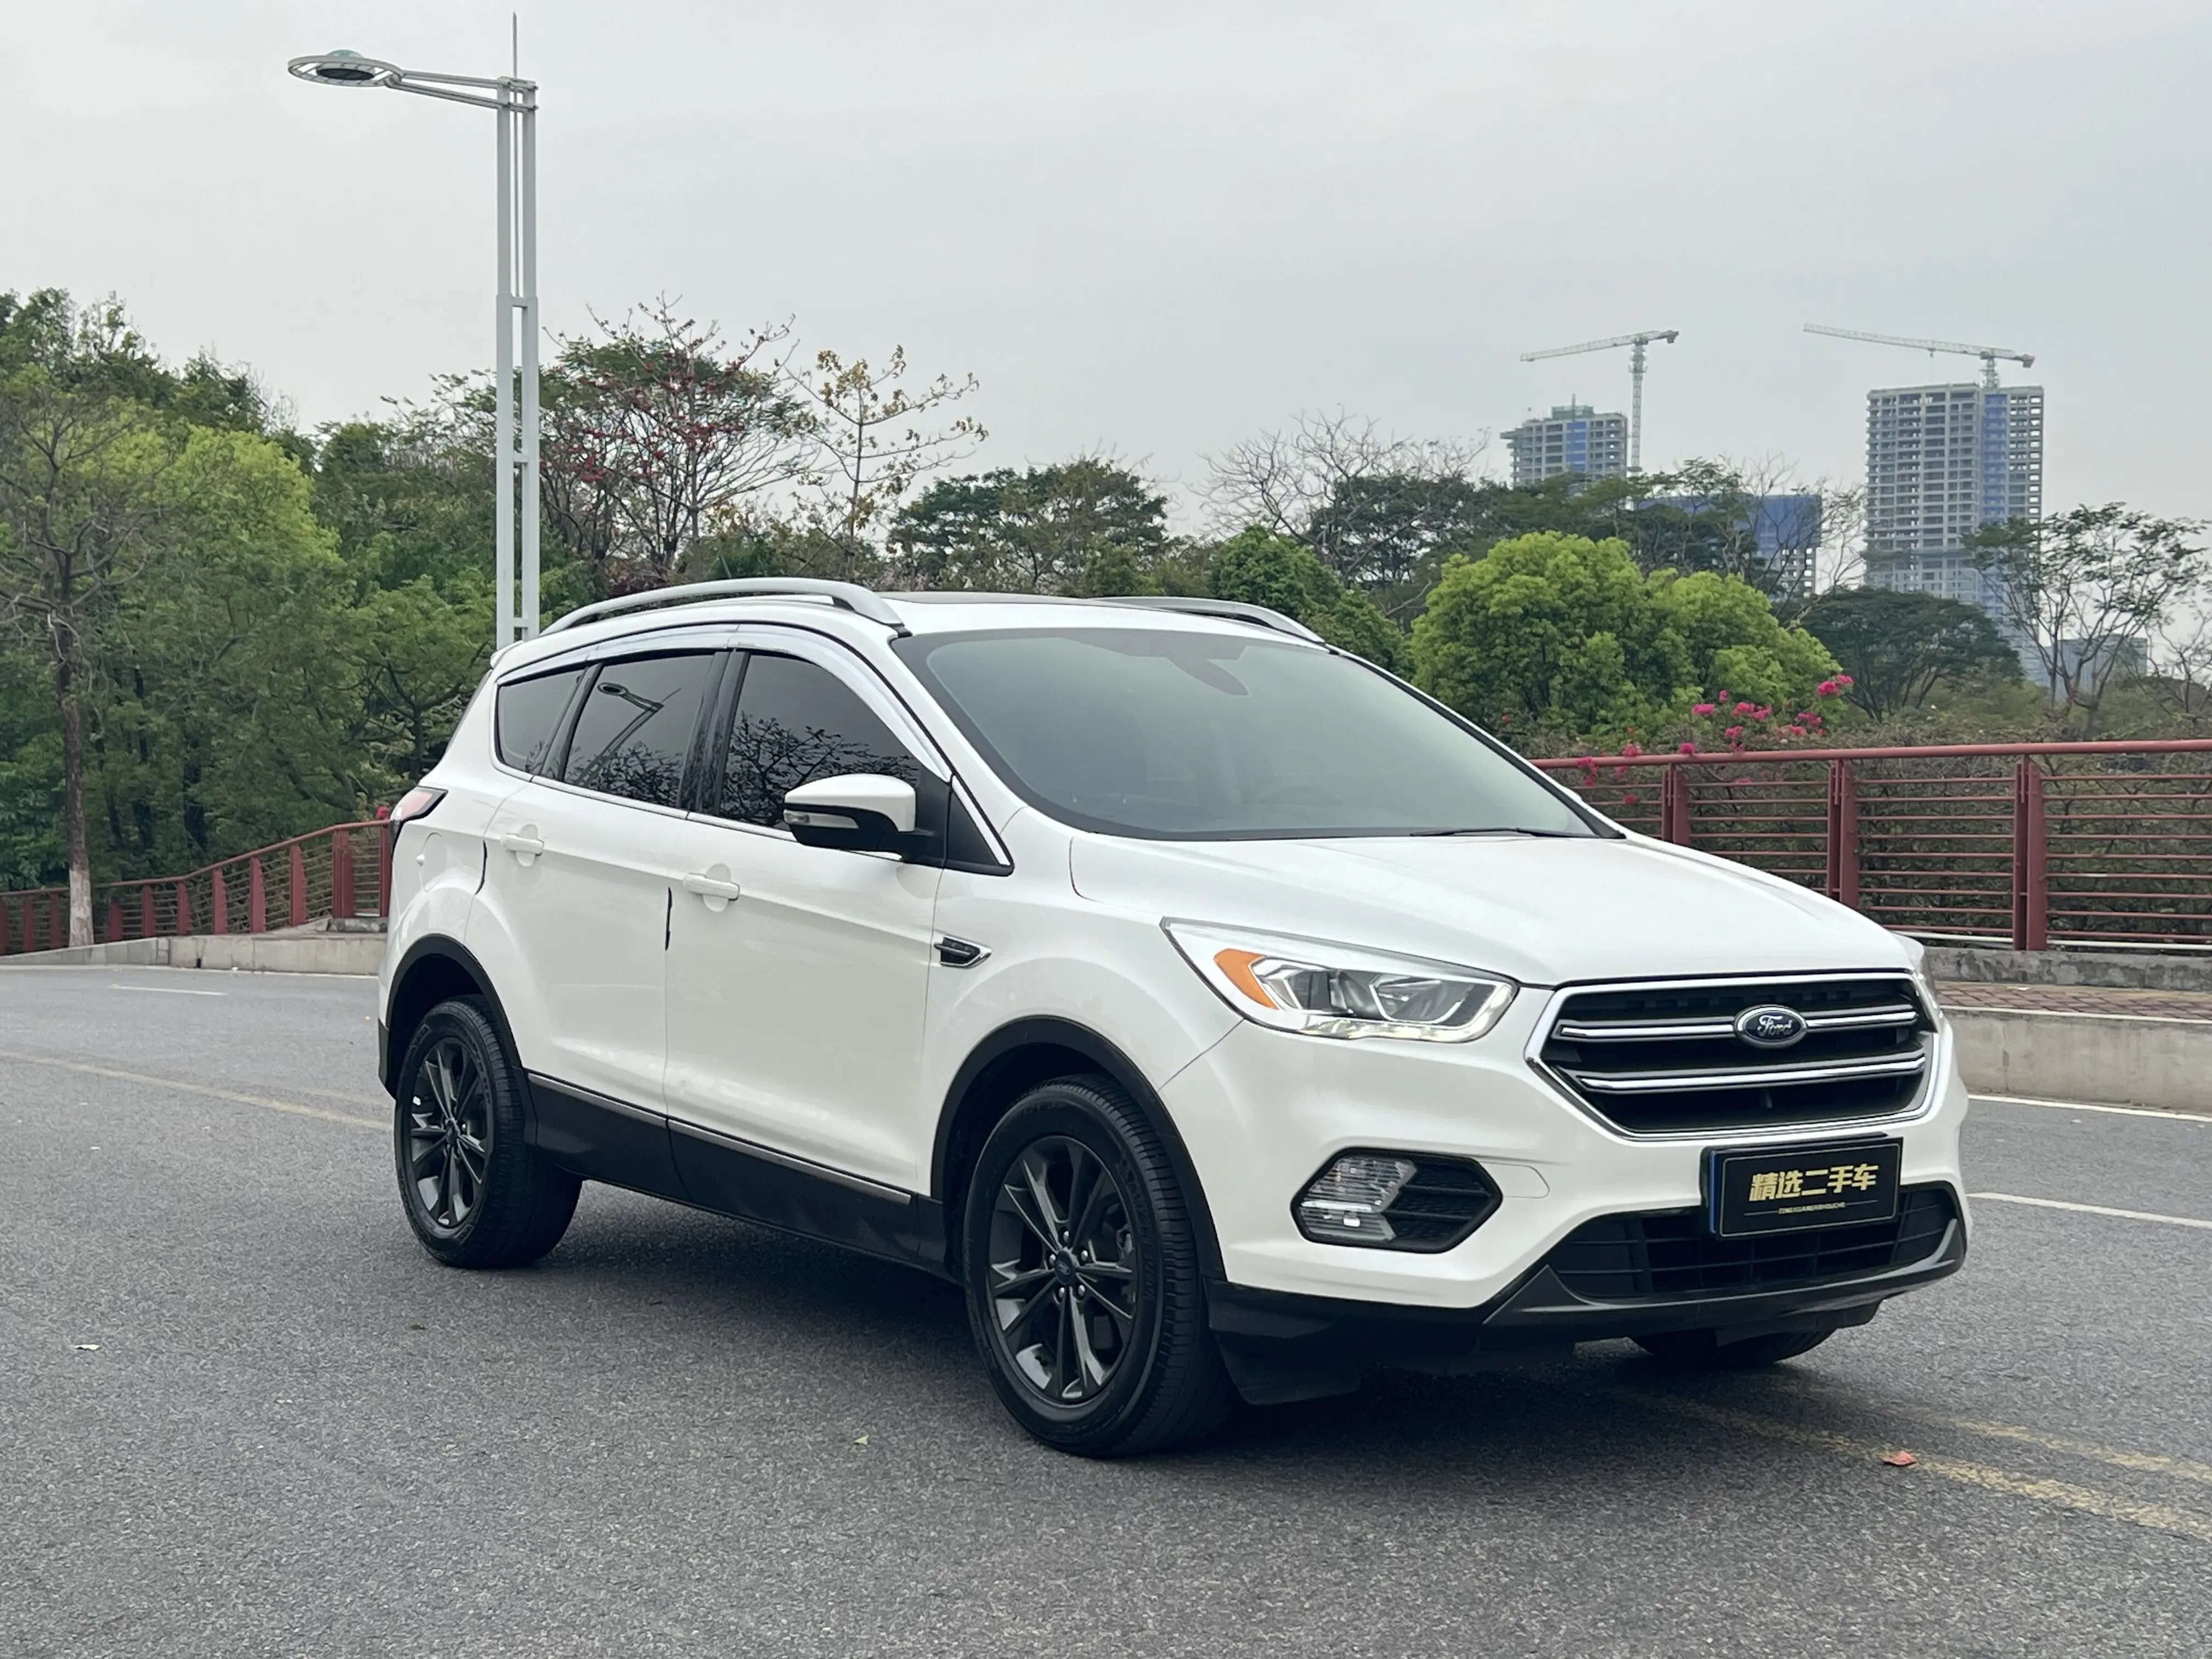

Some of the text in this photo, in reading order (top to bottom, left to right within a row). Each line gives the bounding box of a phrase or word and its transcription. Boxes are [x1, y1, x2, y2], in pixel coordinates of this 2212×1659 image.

[1757, 1015, 1793, 1036] Ford
[1748, 1163, 1878, 1201] 精选二手车
